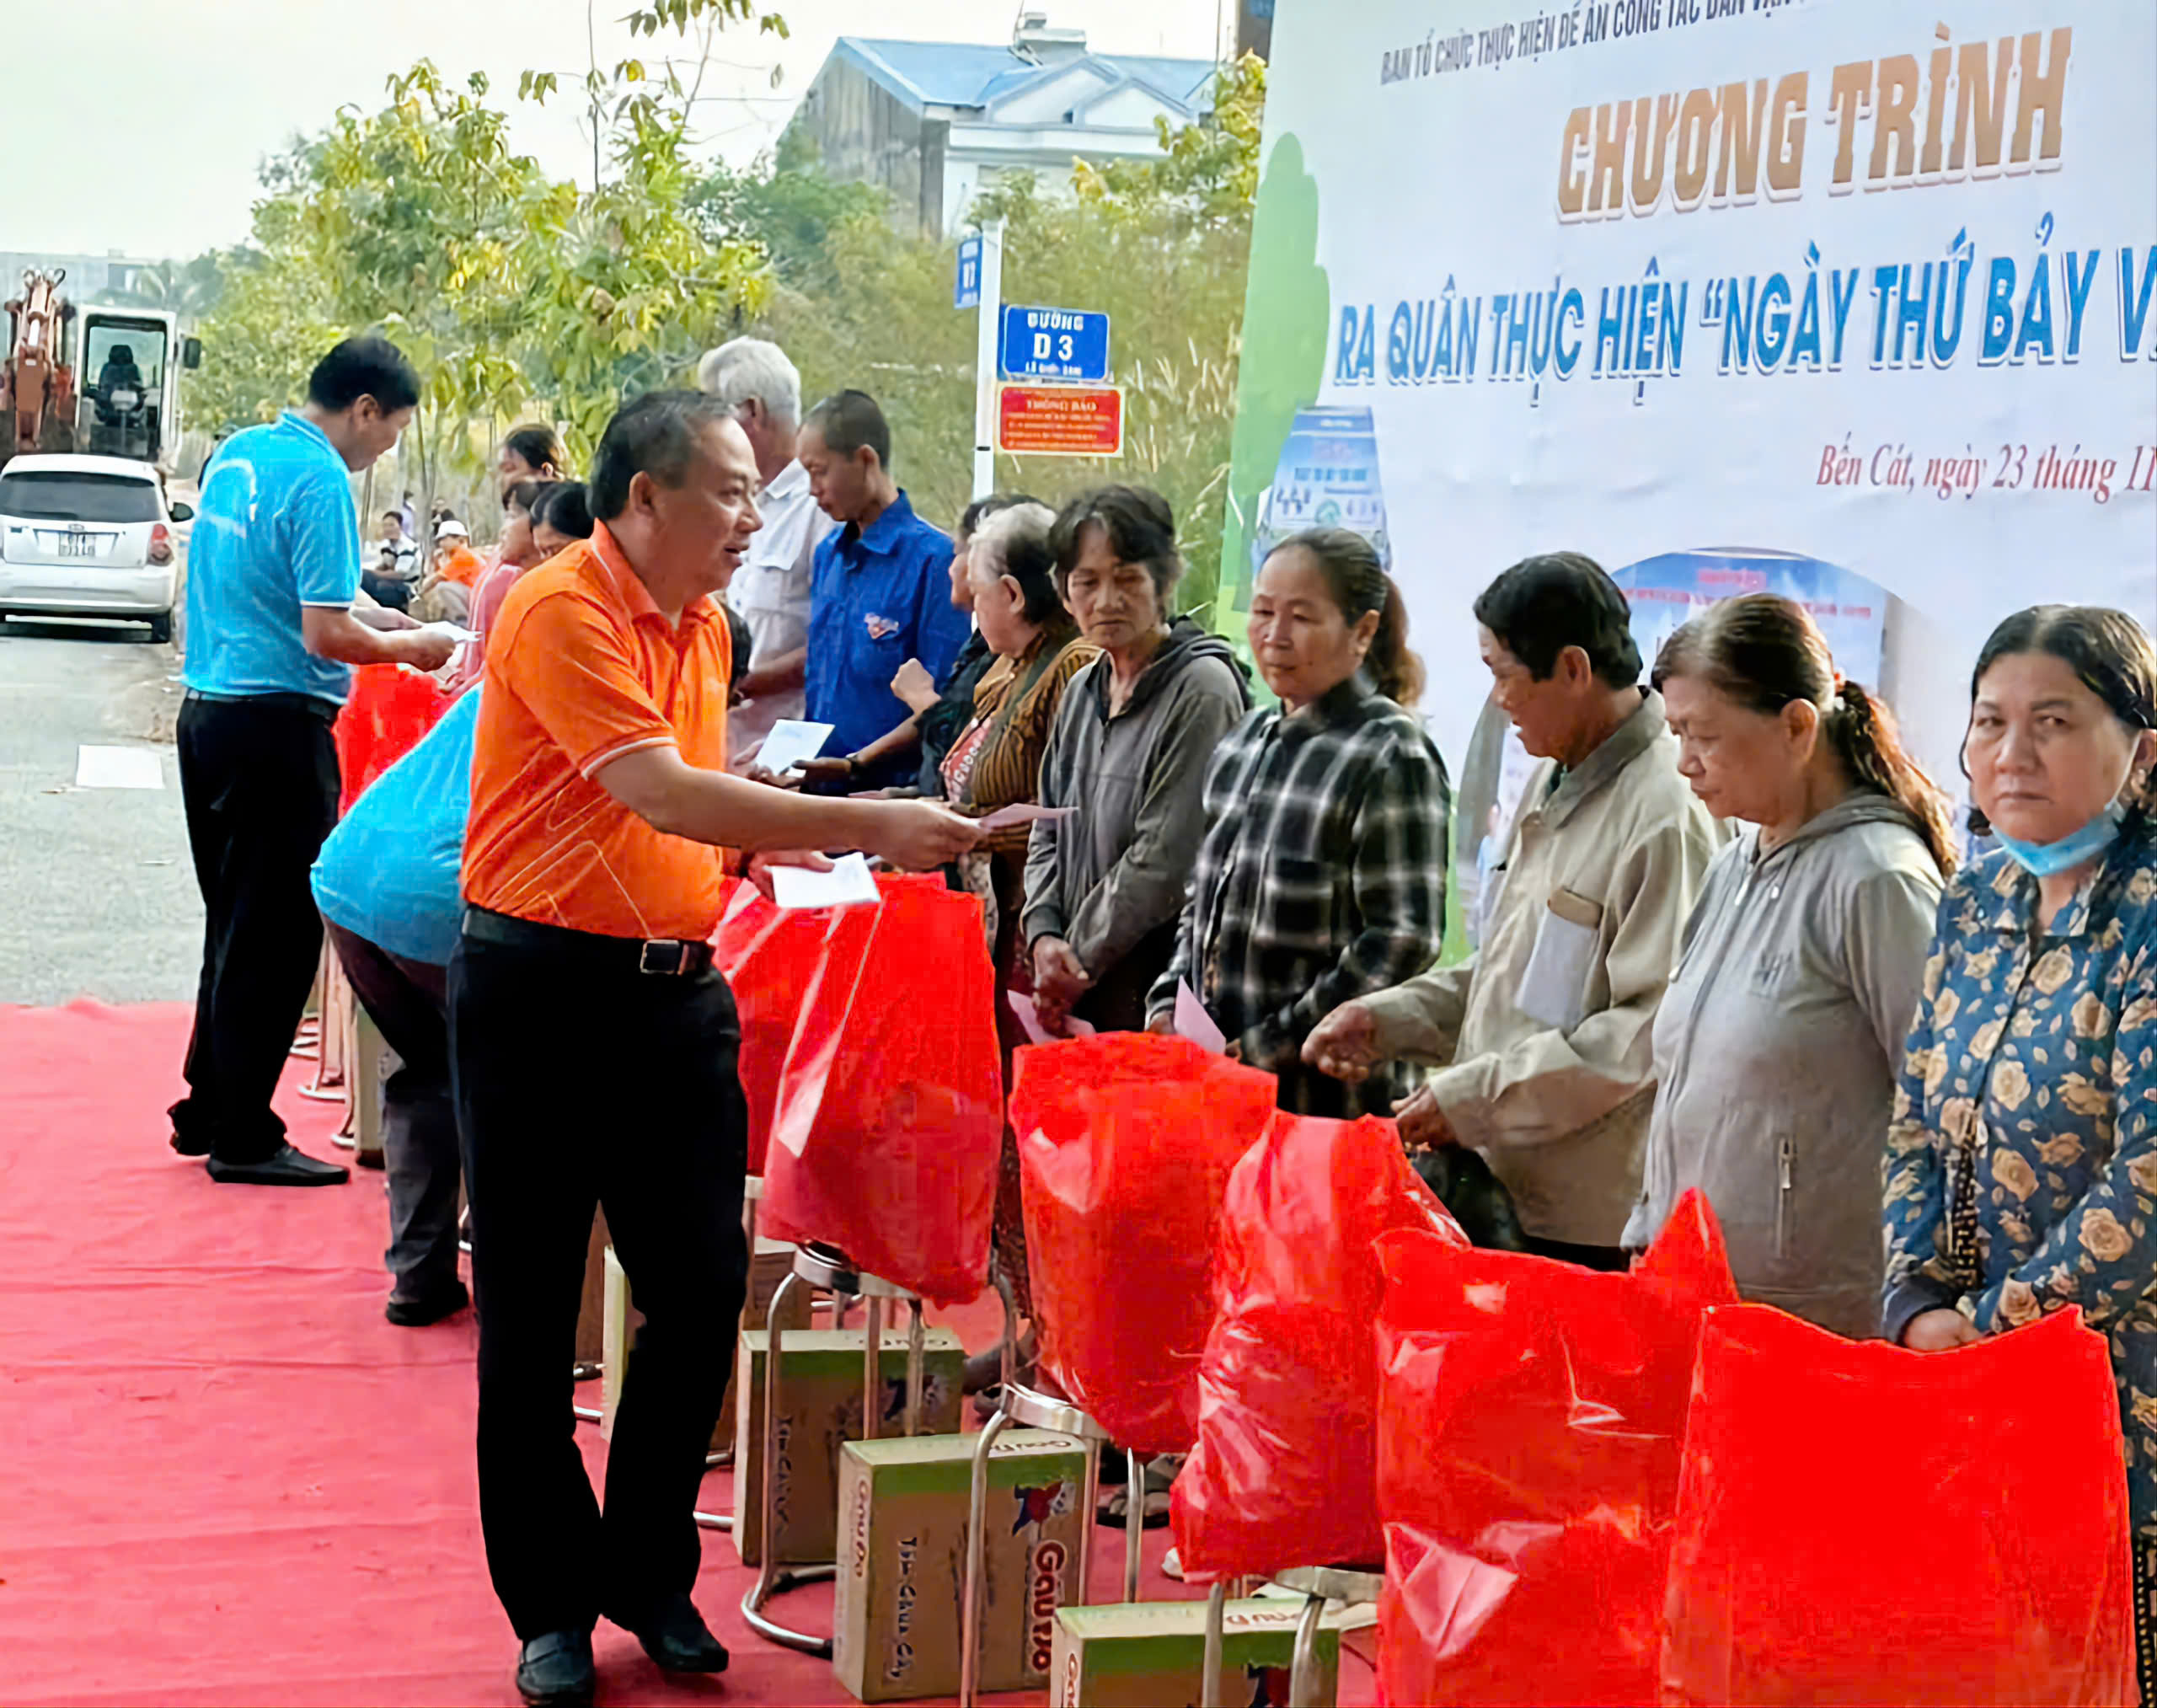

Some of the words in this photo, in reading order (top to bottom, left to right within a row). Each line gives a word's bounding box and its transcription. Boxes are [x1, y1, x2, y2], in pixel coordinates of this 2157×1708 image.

[1380, 47, 1413, 85] BAN
[1435, 28, 1475, 73] CHỨC
[1477, 24, 1515, 71] THỰC
[1517, 10, 1555, 62] HIỆN
[1556, 72, 1809, 224] CHƯƠNG
[1823, 22, 2073, 195] TRÌNH
[1033, 333, 1051, 359] D
[1058, 335, 1073, 361] 3
[1334, 304, 1375, 387] RA
[1387, 273, 1482, 386] QUÂN
[1489, 274, 1584, 408] THỰC
[1591, 255, 1686, 406] HIỆN
[1869, 226, 1975, 370] THỨ
[1977, 211, 2101, 367] BẢY
[2116, 244, 2157, 362] V
[1817, 431, 1862, 486] Bến
[1870, 443, 1915, 494] Cát,
[1923, 443, 1987, 501] ngày
[1993, 443, 2027, 489] 23
[2033, 443, 2117, 504] tháng
